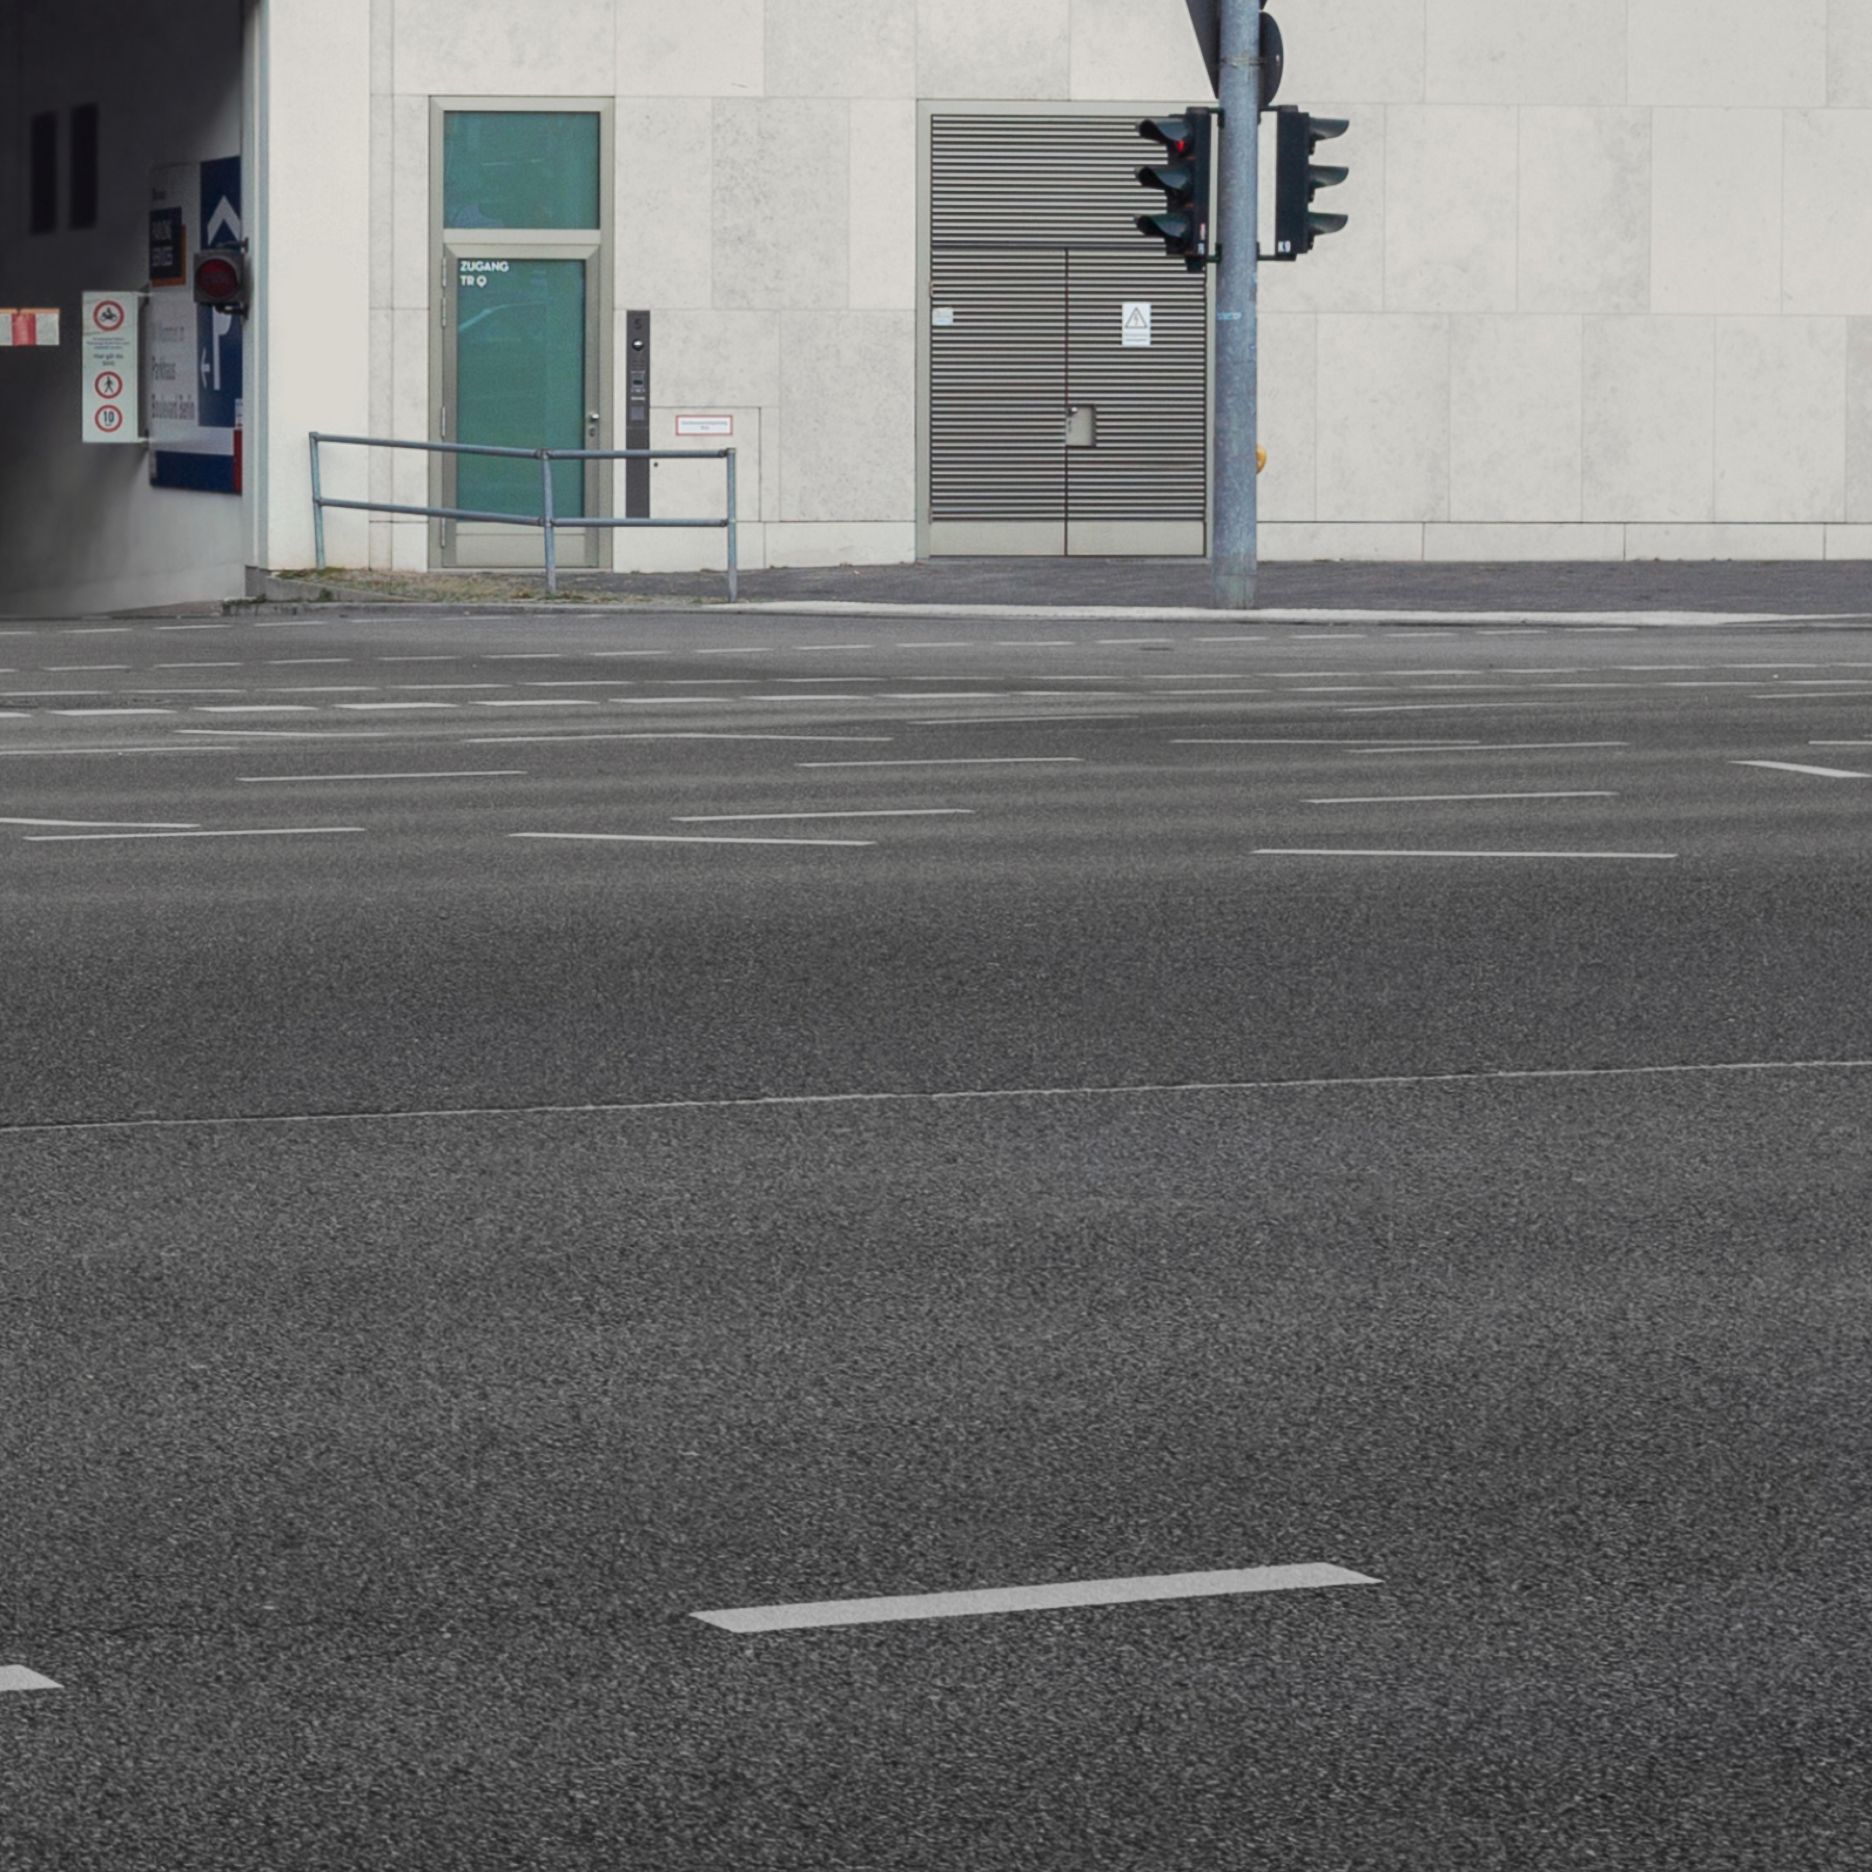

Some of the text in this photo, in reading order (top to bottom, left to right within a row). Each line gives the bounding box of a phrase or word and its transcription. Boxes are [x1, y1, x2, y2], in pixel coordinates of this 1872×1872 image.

[459, 259, 510, 273] ZUGANG
[459, 274, 475, 287] TR
[102, 410, 115, 423] 10
